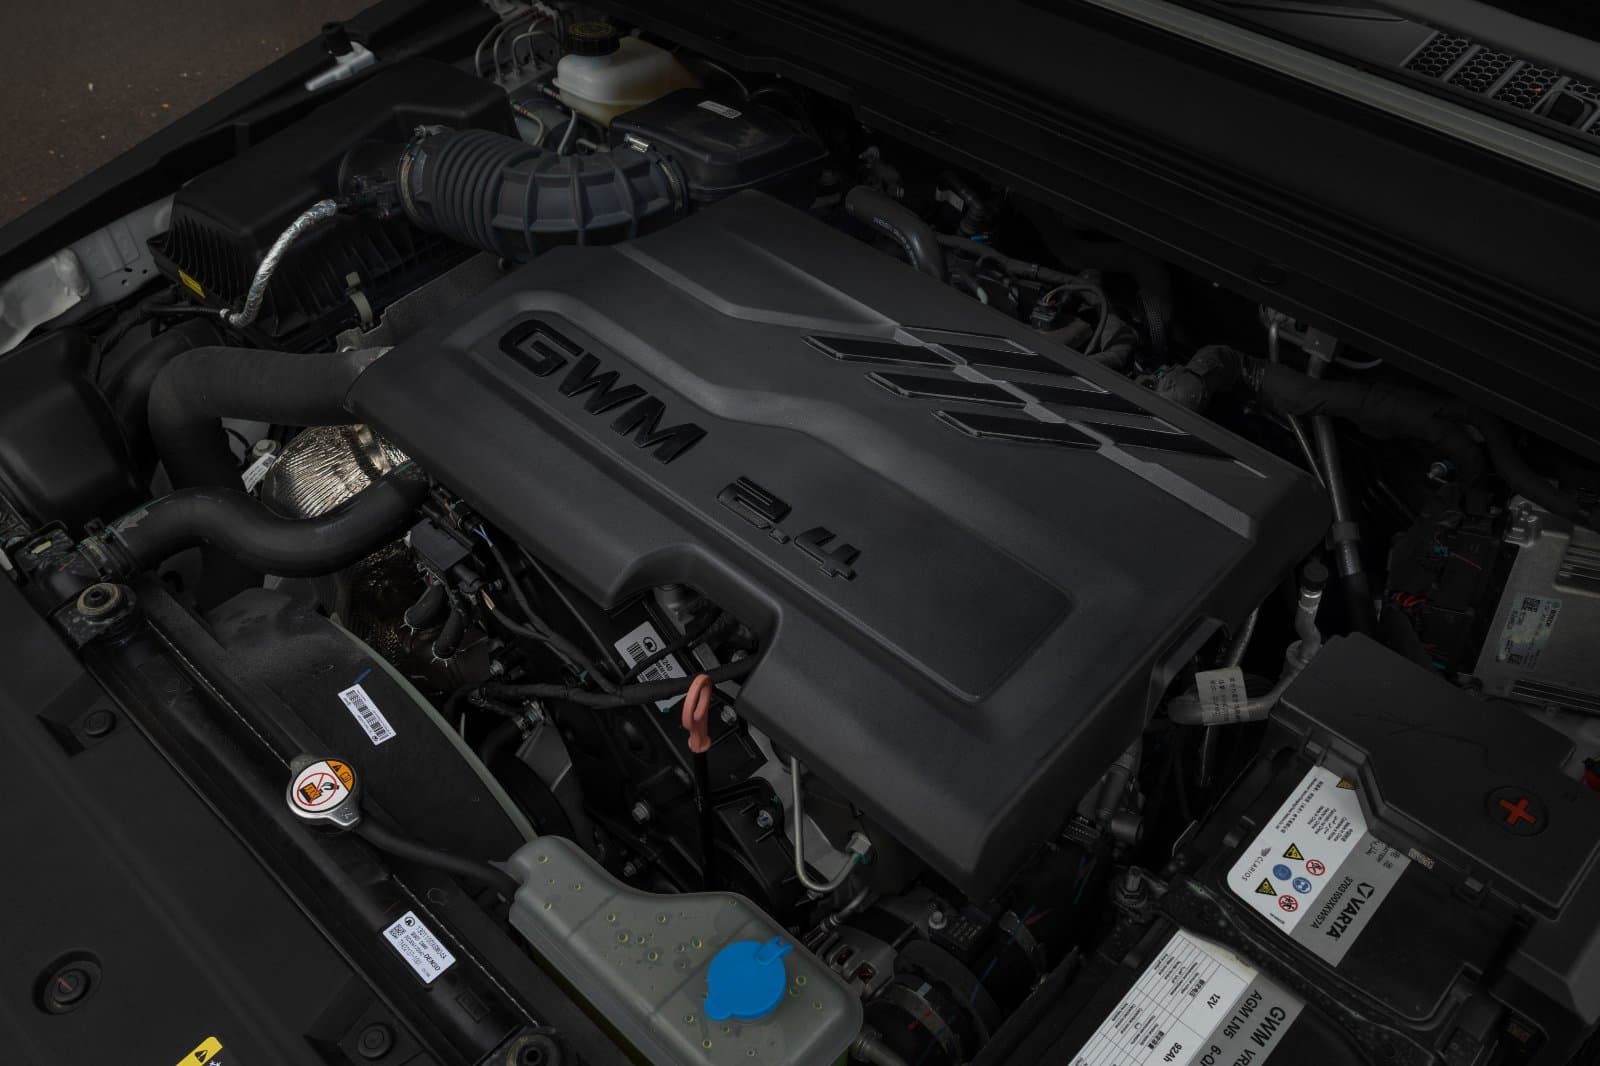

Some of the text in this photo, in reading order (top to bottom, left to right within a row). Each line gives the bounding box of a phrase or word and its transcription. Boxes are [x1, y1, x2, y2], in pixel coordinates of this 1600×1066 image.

[499, 319, 708, 464] GWM
[717, 476, 861, 581] 2.4
[1242, 857, 1263, 881] CLARIOS
[1326, 898, 1365, 938] VARTA
[1207, 993, 1221, 1009] 12V
[1239, 990, 1262, 1018] AGM
[1223, 1016, 1245, 1039] LN5
[1251, 1006, 1286, 1047] GWM
[1163, 1042, 1183, 1062] 92Ah
